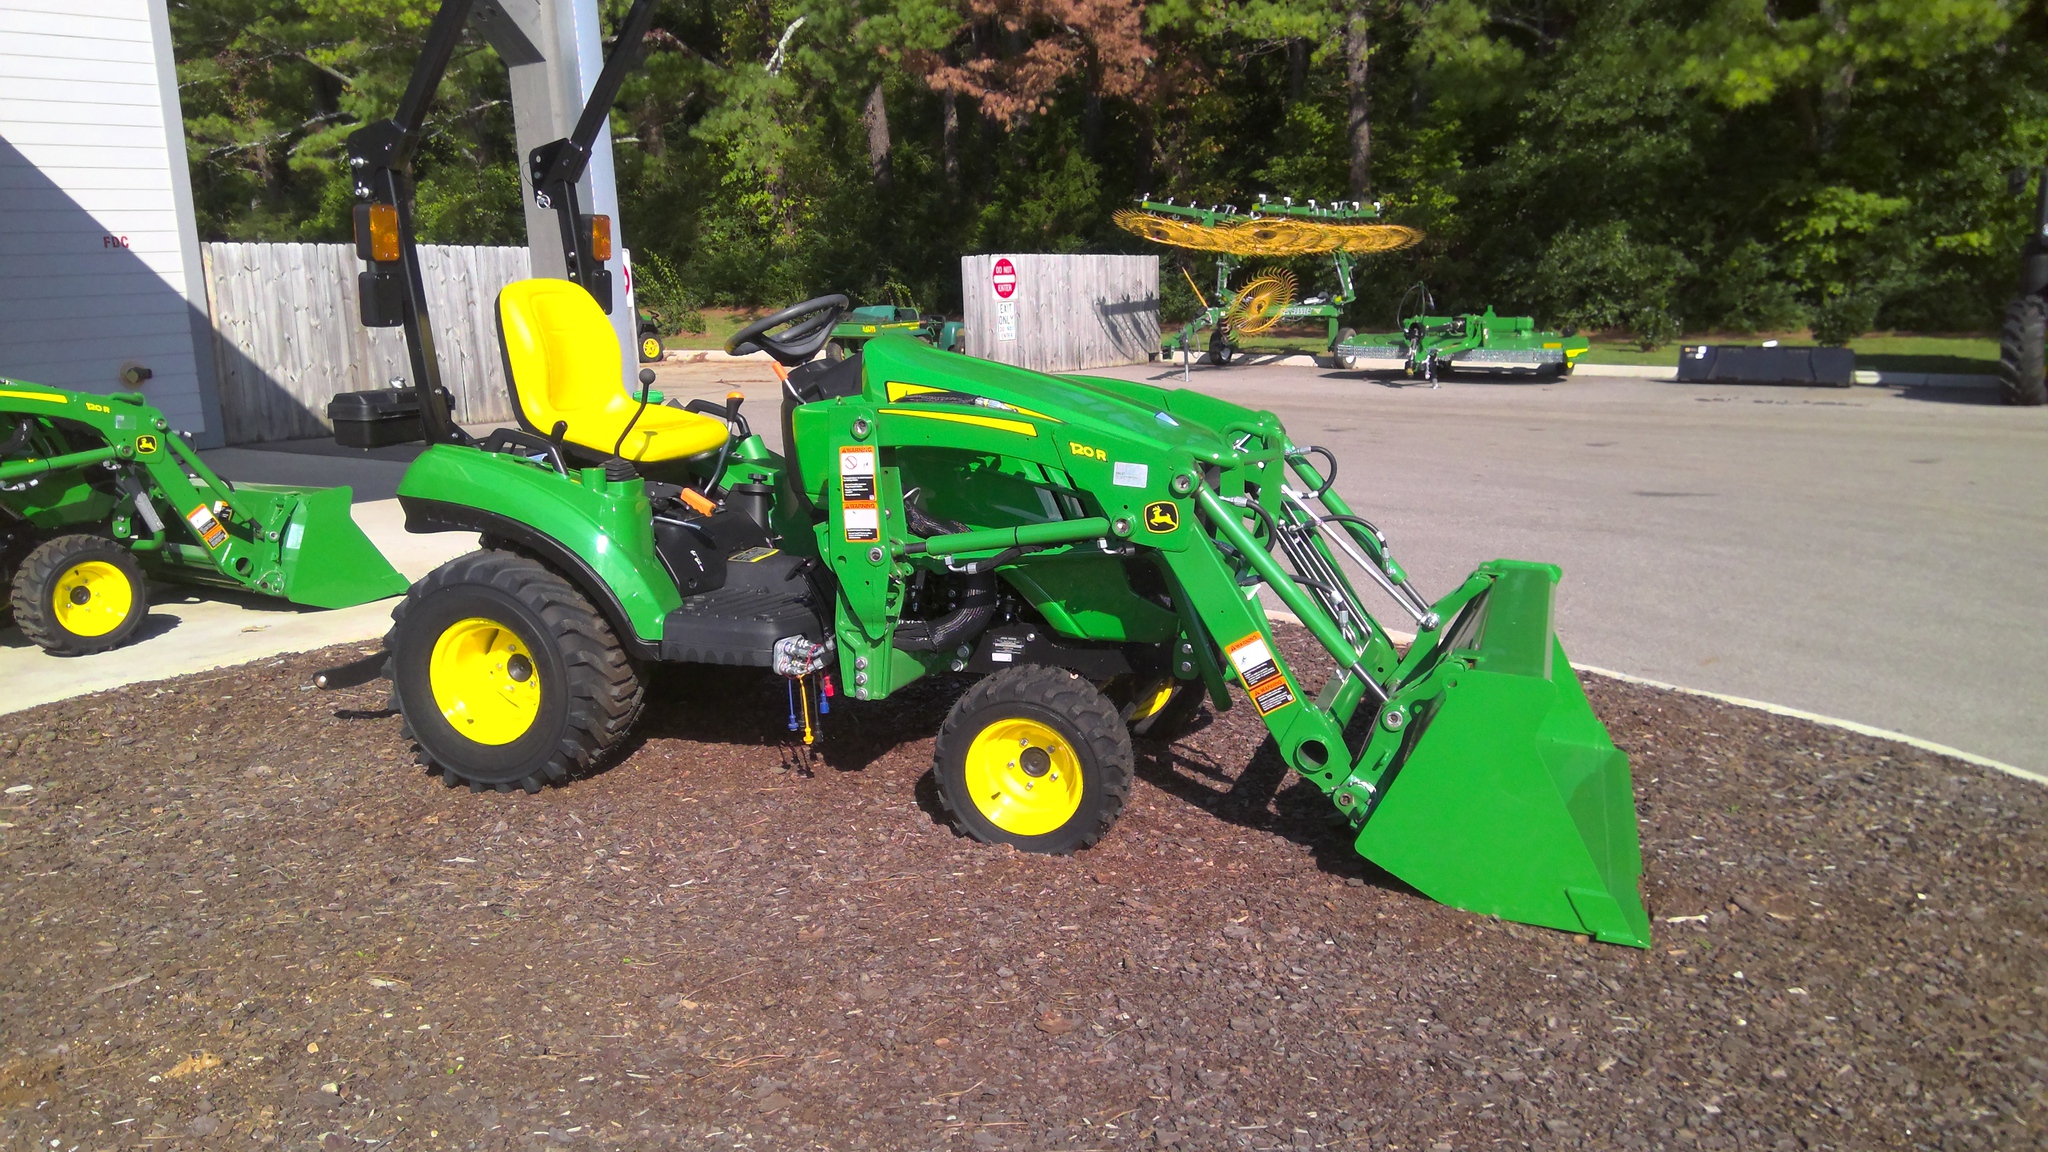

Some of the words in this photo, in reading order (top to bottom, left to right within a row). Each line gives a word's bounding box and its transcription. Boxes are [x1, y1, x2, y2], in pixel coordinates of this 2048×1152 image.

[103, 235, 129, 249] FDC
[995, 265, 1002, 274] DO
[1003, 265, 1013, 274] NOT
[997, 284, 1012, 292] ENTER
[999, 303, 1012, 314] EXIT
[999, 315, 1014, 325] ONLY
